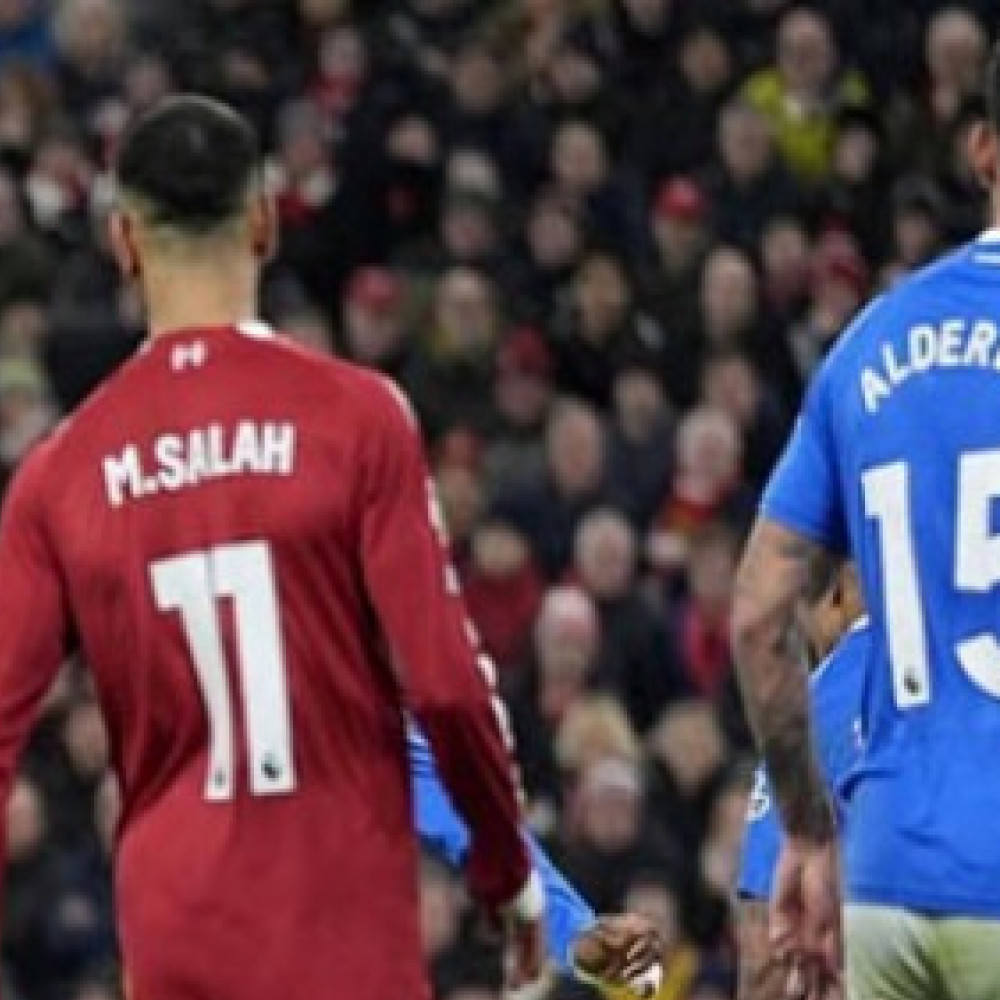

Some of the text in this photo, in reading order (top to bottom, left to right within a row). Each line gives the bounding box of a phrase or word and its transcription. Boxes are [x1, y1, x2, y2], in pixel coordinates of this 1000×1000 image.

[860, 317, 1000, 414] ALDER
[104, 419, 297, 508] M.SALAH
[147, 540, 298, 803] 11
